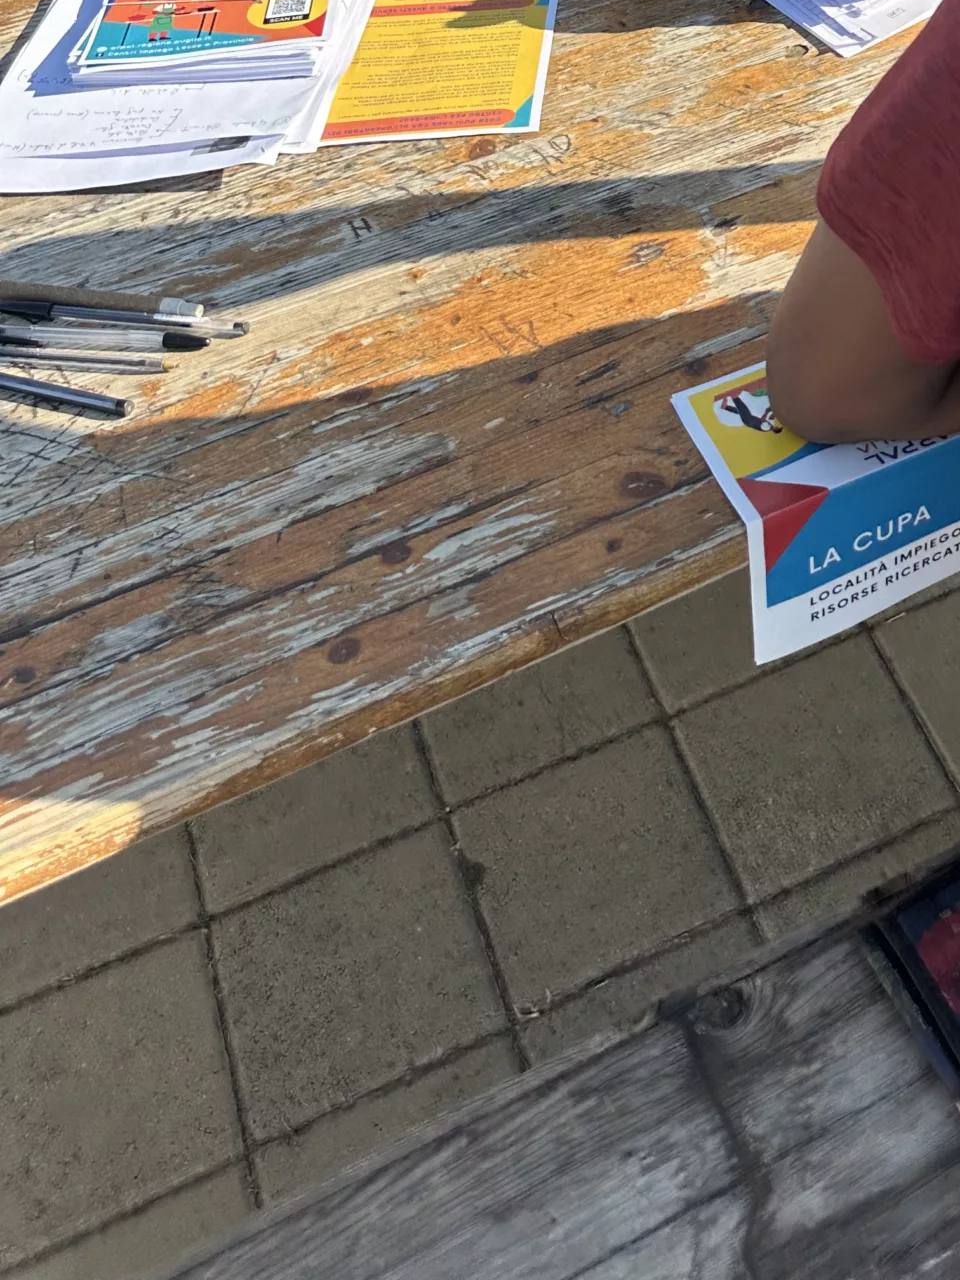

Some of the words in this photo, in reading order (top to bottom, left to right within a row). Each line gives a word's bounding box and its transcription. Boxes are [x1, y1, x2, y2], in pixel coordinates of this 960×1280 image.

[269, 16, 290, 24] SCAN
[108, 49, 136, 57] Centri
[864, 435, 949, 465] RPAL
[808, 546, 842, 576] LA
[853, 504, 932, 553] CUPA
[810, 562, 888, 606] LOCALITÀ
[810, 582, 879, 622] RISORSE
